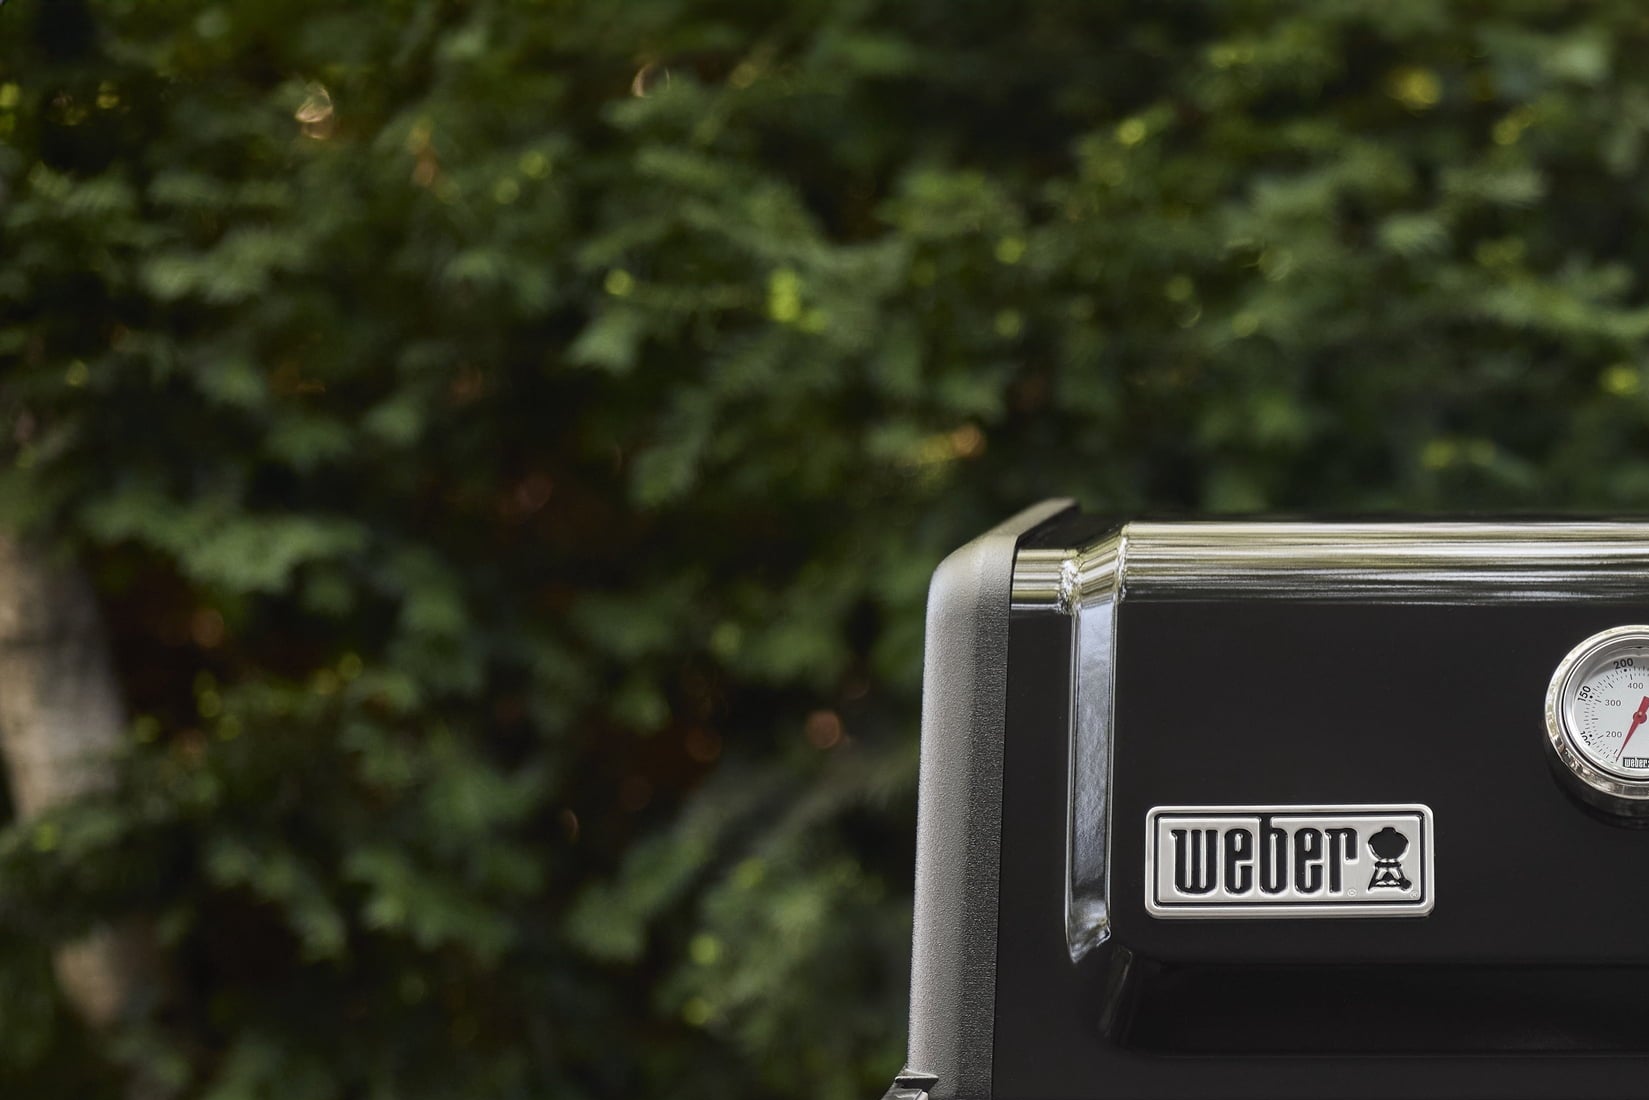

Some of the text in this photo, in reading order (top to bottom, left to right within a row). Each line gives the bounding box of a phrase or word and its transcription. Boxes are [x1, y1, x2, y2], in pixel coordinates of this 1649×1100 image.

[1613, 658, 1633, 670] 200
[1578, 685, 1591, 702] 150
[1605, 699, 1622, 707] 300
[1624, 757, 1648, 768] weber
